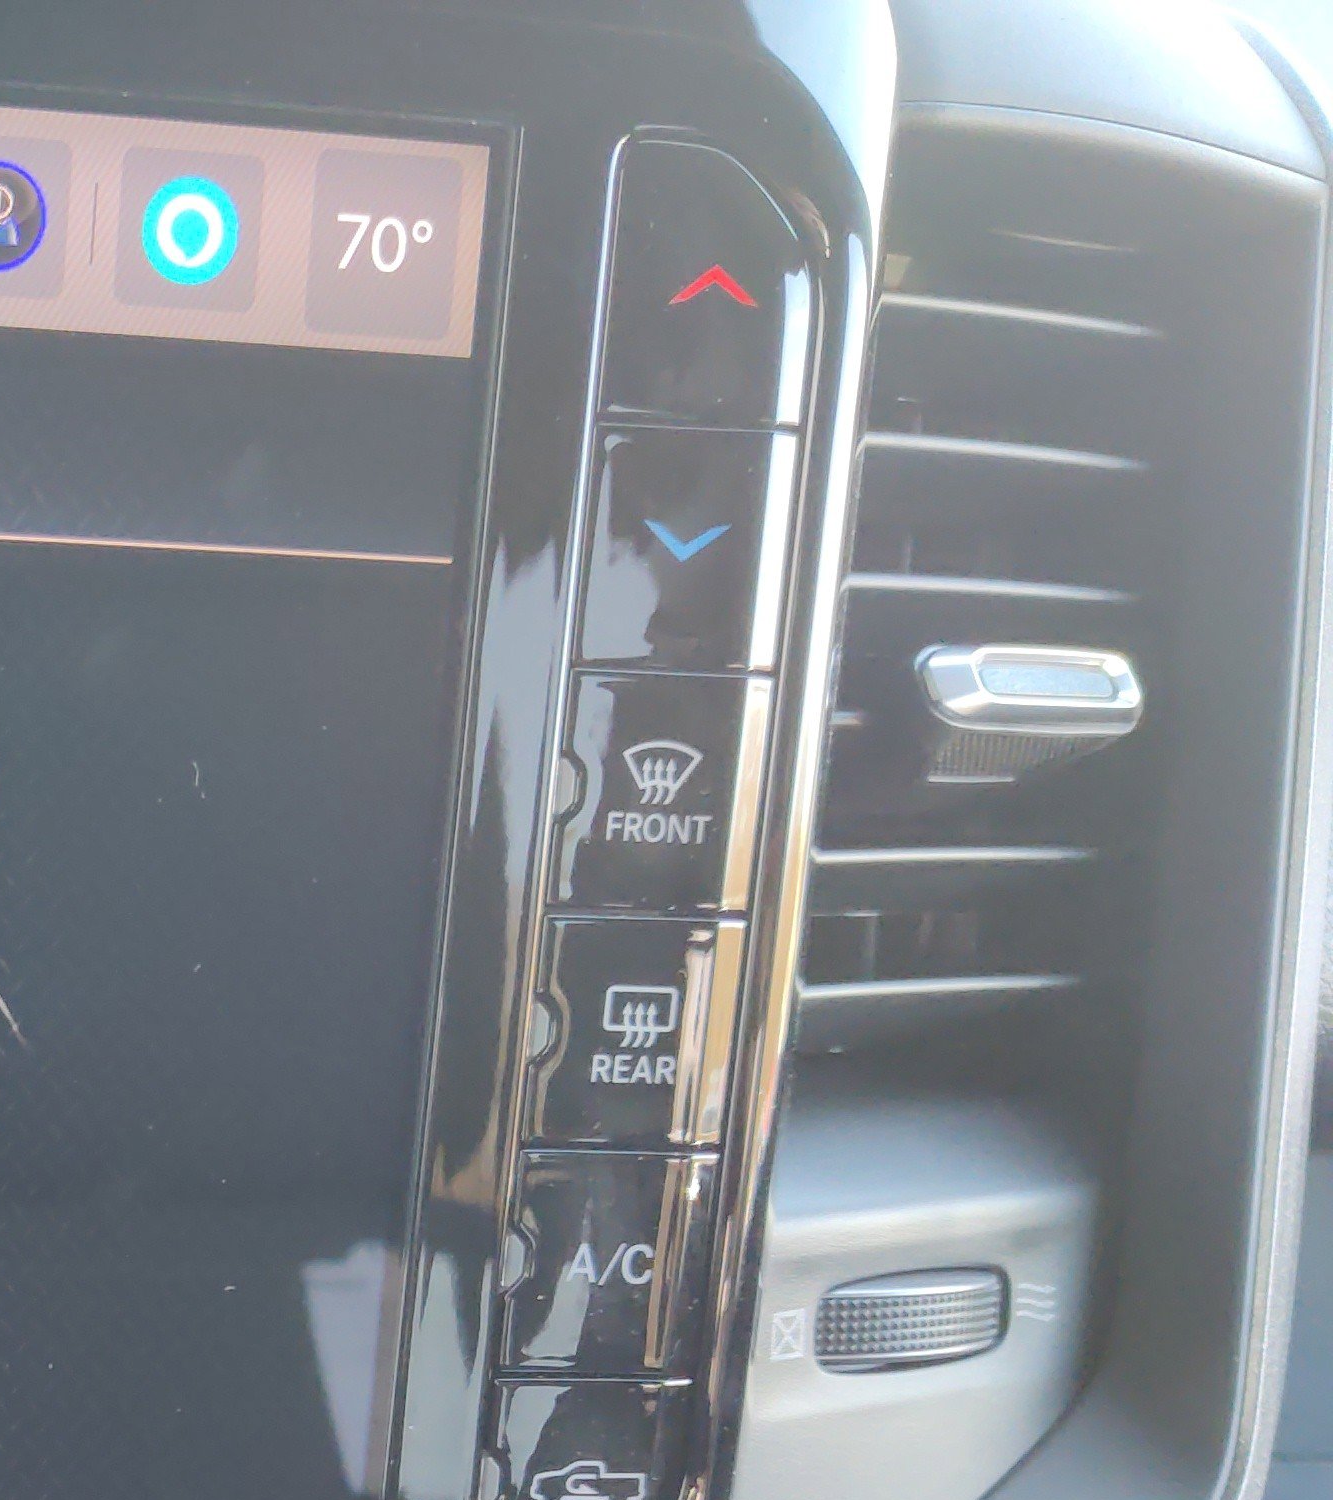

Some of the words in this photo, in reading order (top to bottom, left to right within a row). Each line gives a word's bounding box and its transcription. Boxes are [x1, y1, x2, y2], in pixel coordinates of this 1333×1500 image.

[336, 213, 434, 273] 70°
[605, 810, 713, 845] FRONT
[590, 1054, 678, 1085] REAR
[566, 1243, 655, 1286] A/C
